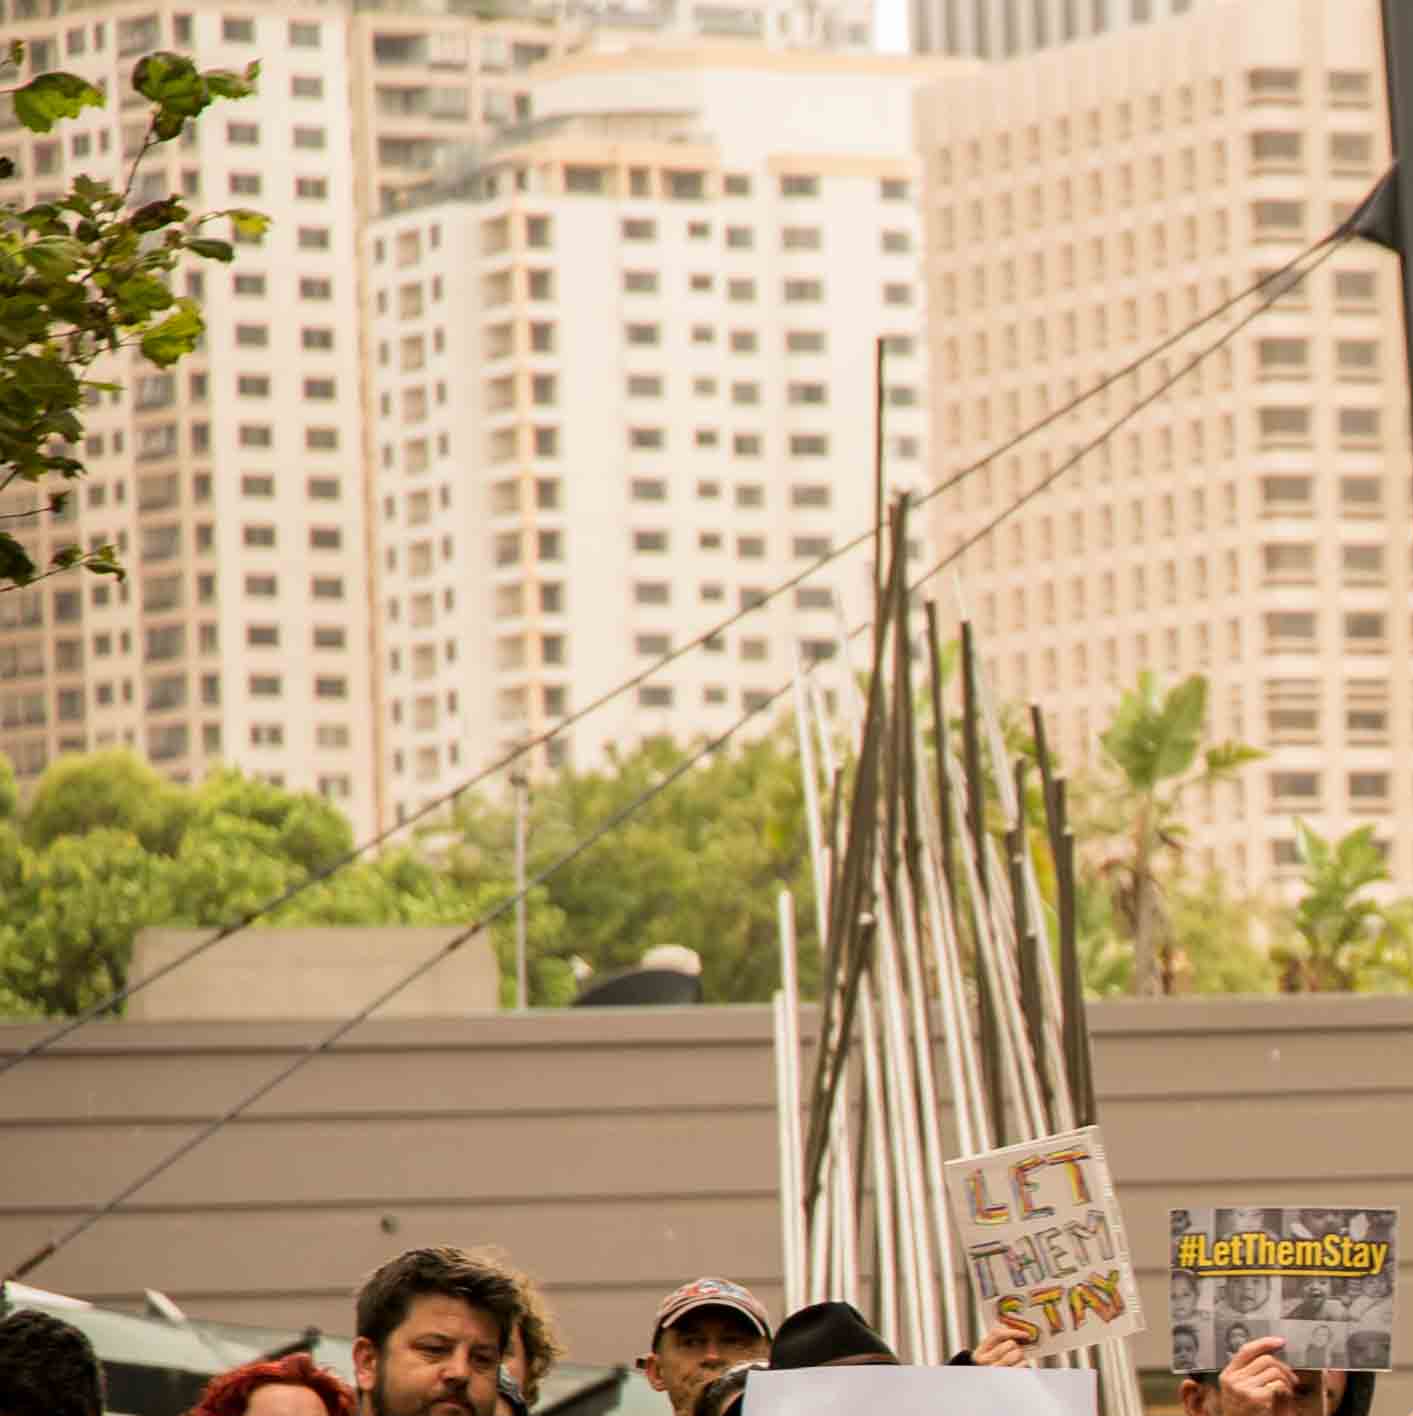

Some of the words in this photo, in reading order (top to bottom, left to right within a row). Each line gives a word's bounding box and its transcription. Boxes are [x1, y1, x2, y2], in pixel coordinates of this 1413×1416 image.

[964, 1146, 1092, 1225] LET
[968, 1210, 1116, 1299] THEM
[1178, 1232, 1389, 1276] #LetThemStay
[997, 1269, 1126, 1344] STAY
